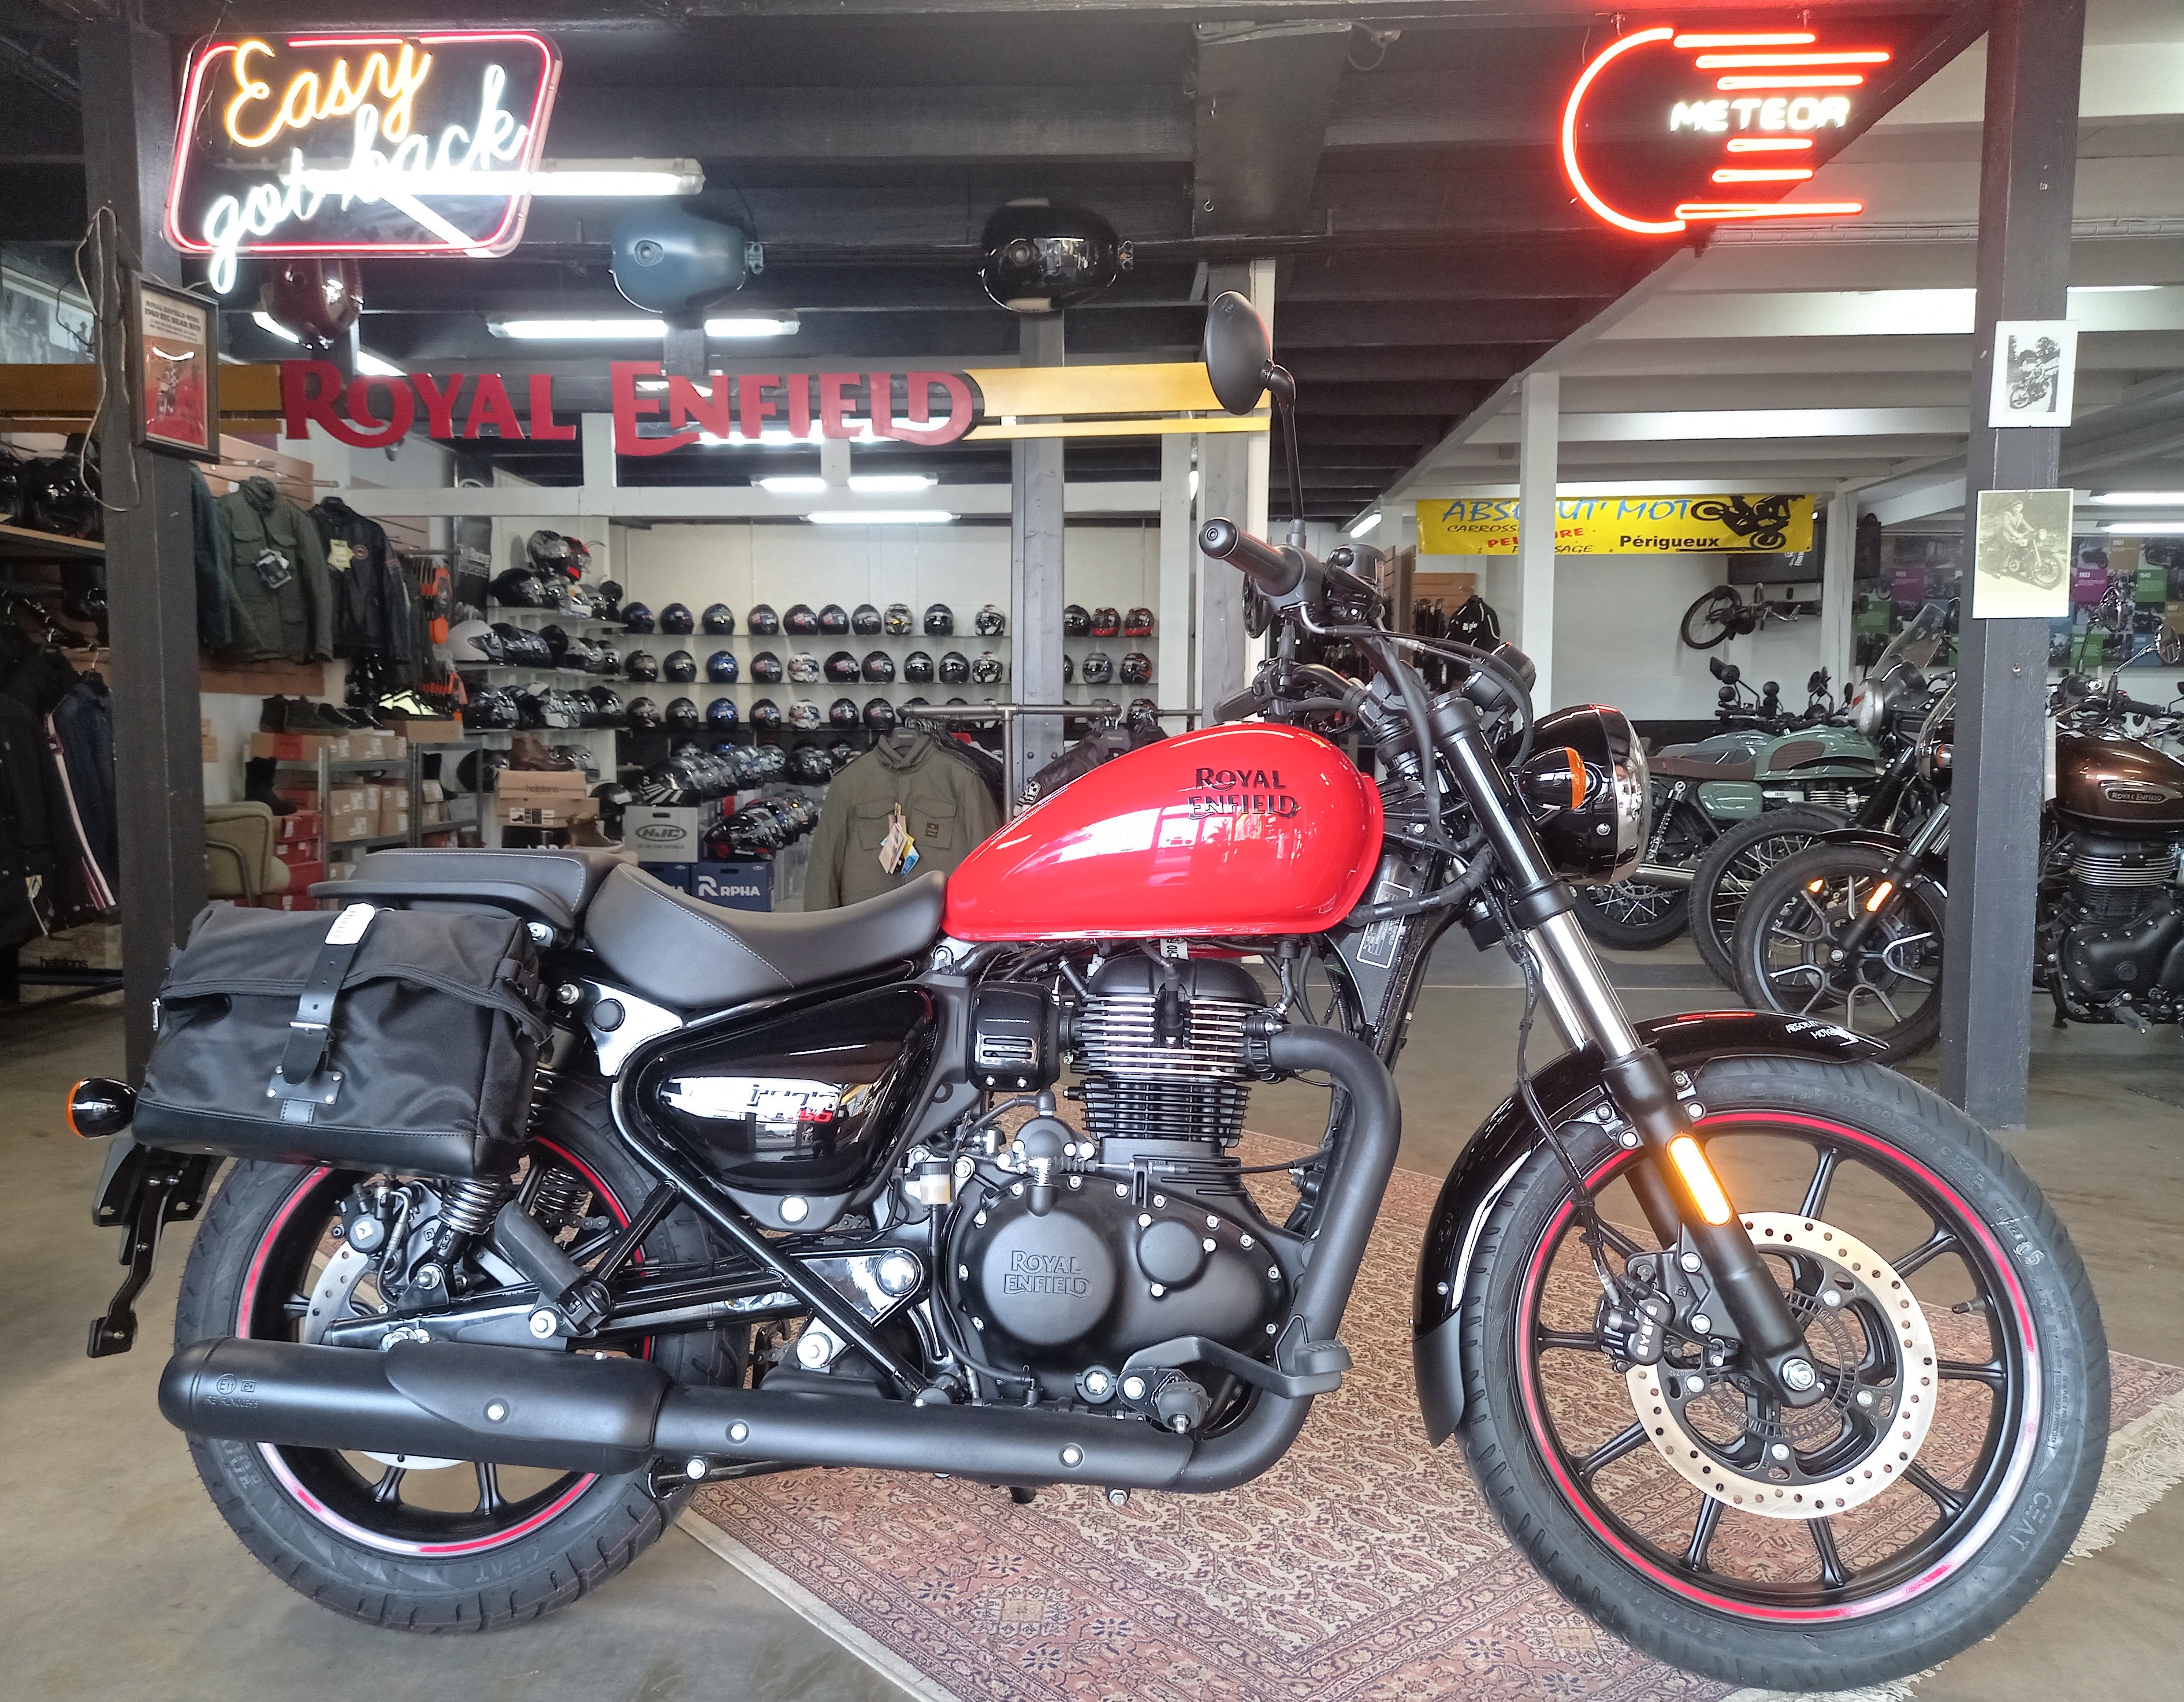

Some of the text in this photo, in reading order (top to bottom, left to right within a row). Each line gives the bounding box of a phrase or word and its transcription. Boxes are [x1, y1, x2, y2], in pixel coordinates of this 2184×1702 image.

[225, 38, 431, 147] Easy
[1670, 96, 1851, 132] METEOR
[203, 103, 527, 295] got back
[281, 359, 974, 456] ROYAL ENFIELD
[1619, 535, 1720, 549] Périgueux
[1195, 768, 1286, 792] ROYAL
[1188, 795, 1300, 820] ENFIELD
[2112, 792, 2135, 800] ROYAL
[642, 829, 680, 838] HJC
[720, 886, 761, 897] RPHA
[1011, 1250, 1082, 1274] ROYAL
[1003, 1273, 1093, 1299] ENFIELD
[2010, 1492, 2052, 1552] CEAT
[475, 1543, 540, 1583] CEAT
